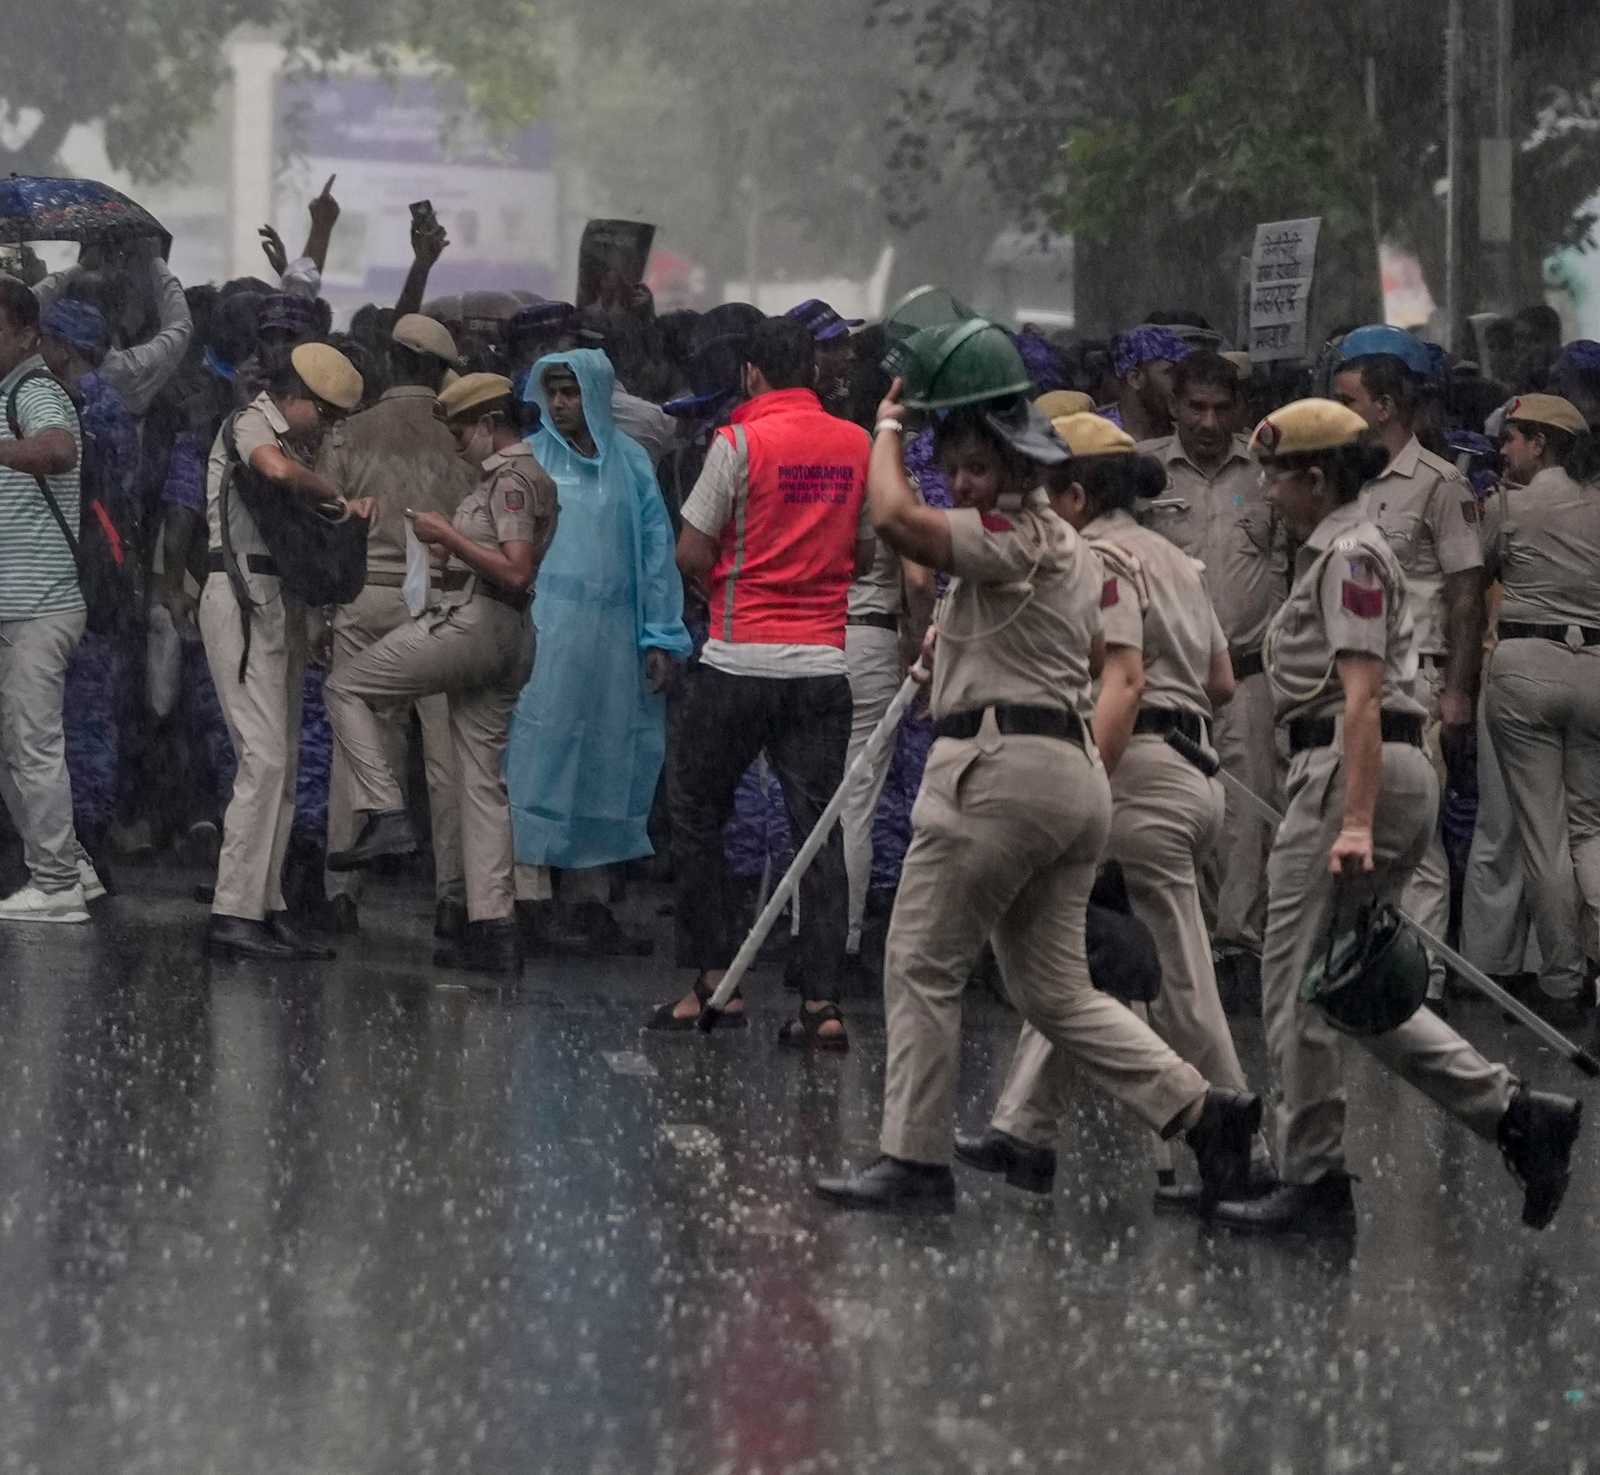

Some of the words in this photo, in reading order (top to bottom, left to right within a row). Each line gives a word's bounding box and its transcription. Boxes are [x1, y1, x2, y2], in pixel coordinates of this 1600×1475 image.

[778, 465, 854, 480] PHOTOGRAPHER
[784, 492, 811, 504] DELHI
[814, 492, 847, 505] POLICE
